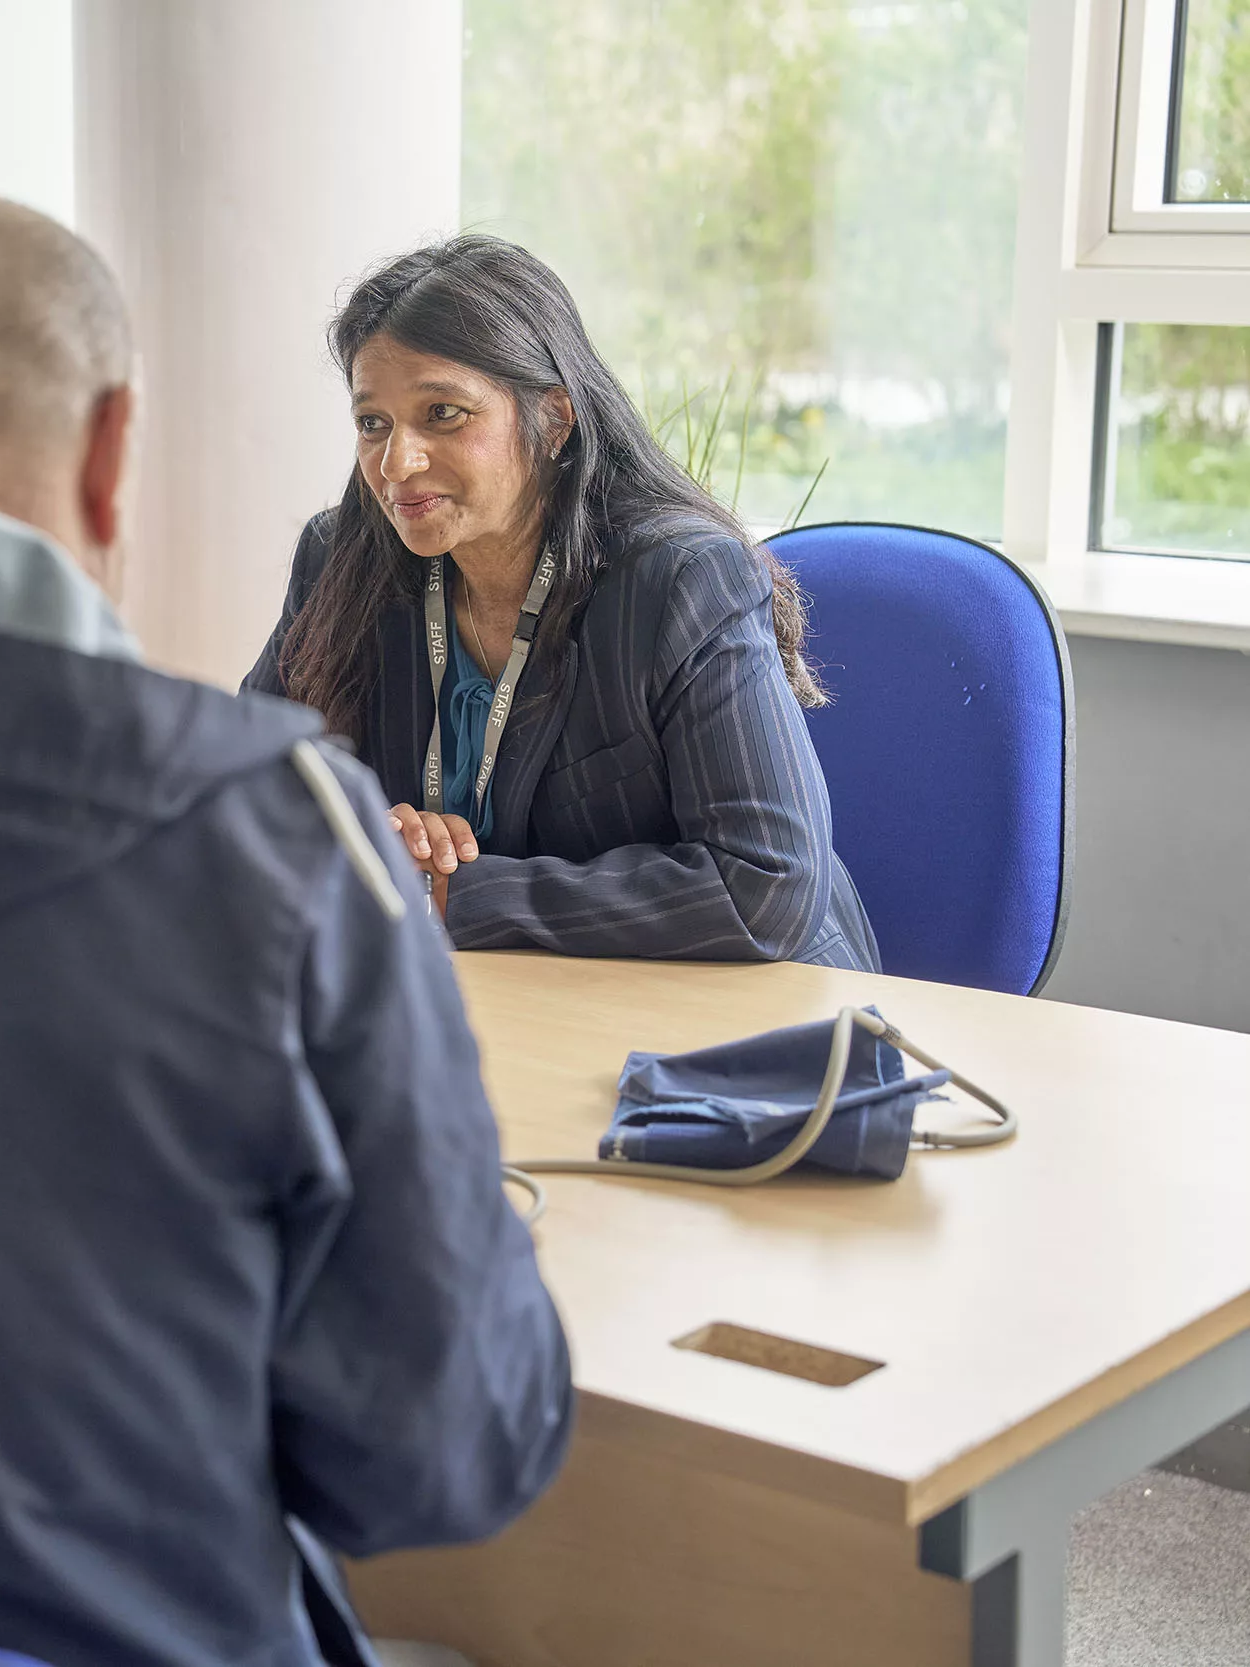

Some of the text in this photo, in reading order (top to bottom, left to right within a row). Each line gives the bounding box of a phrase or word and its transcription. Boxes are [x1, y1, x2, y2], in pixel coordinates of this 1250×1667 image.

[428, 557, 442, 592] STAF
[430, 621, 445, 665] STAFF
[491, 682, 511, 728] STAFF
[428, 752, 439, 797] STAFF
[475, 754, 493, 799] STAFF
